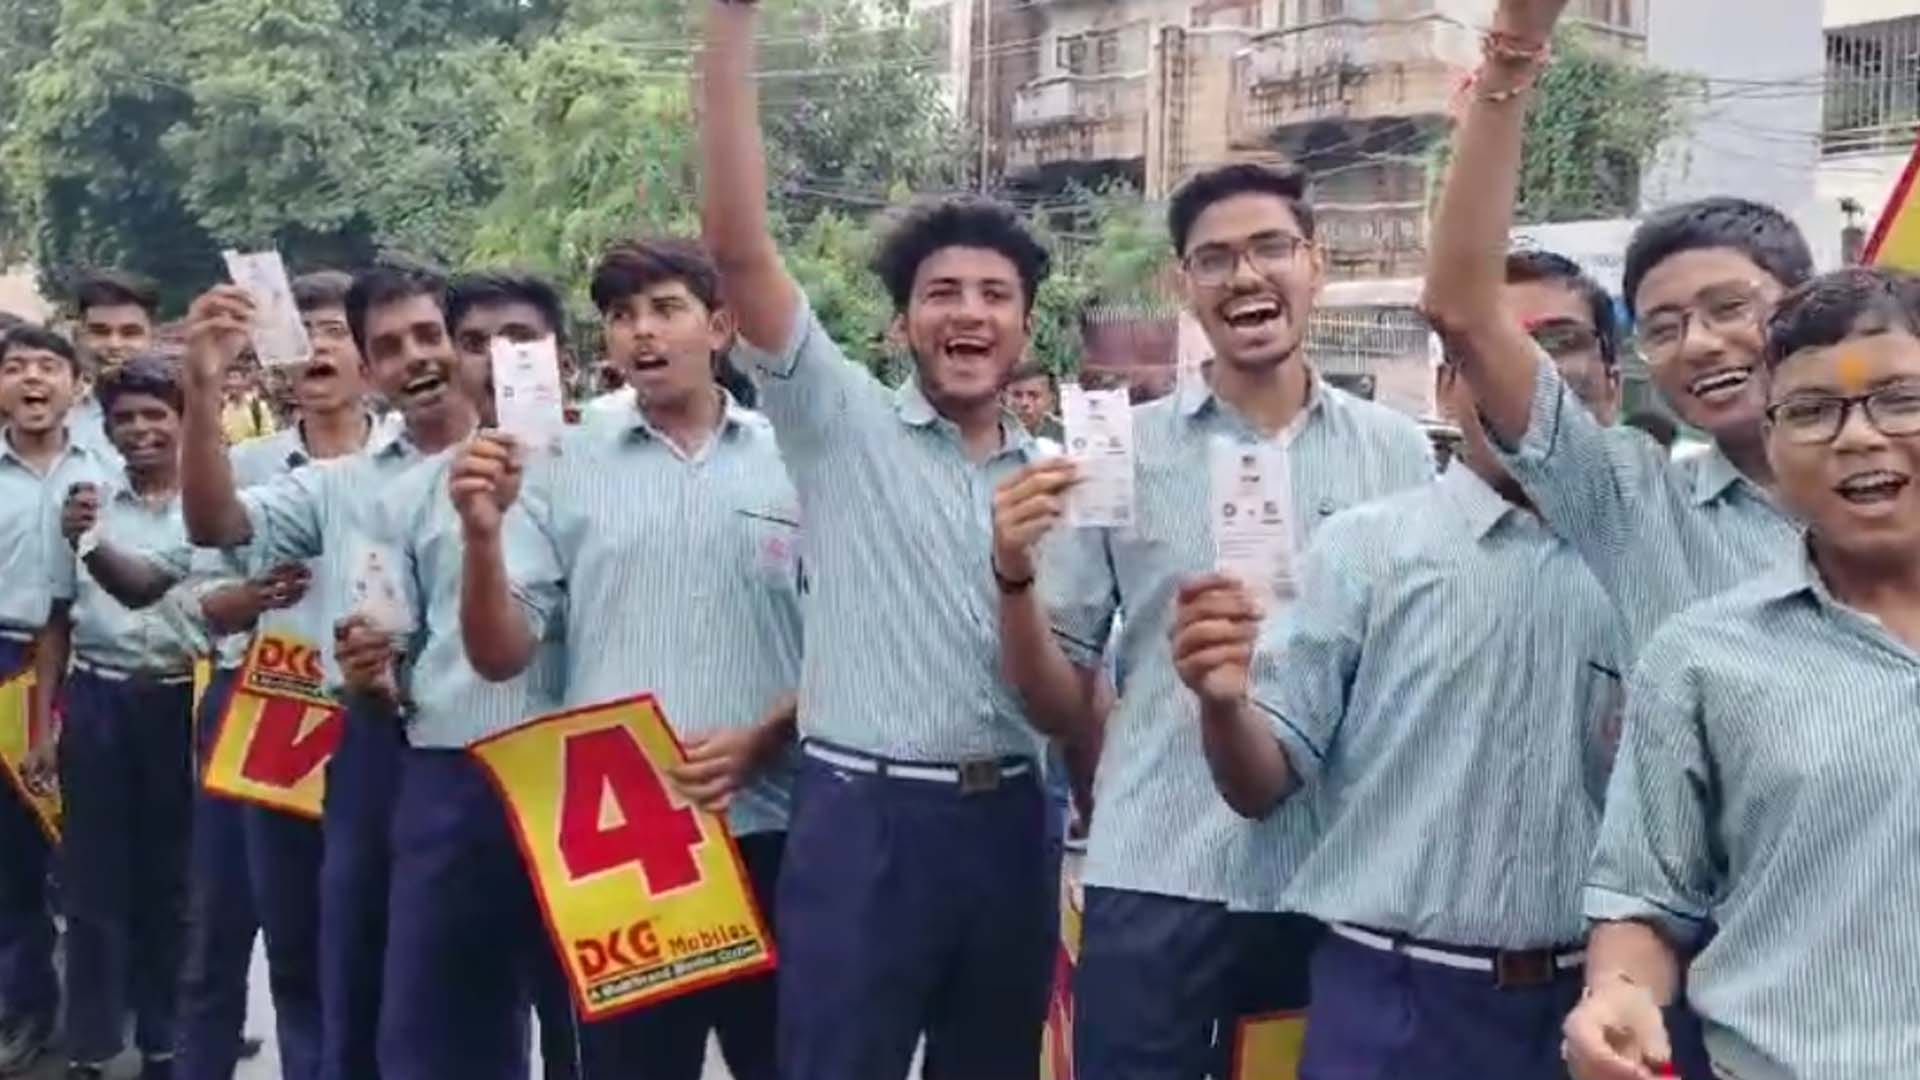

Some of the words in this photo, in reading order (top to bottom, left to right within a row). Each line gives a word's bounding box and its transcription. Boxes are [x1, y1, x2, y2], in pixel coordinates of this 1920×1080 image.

[558, 723, 707, 896] 4
[574, 918, 661, 979] DKG
[668, 922, 752, 957] Mobiles
